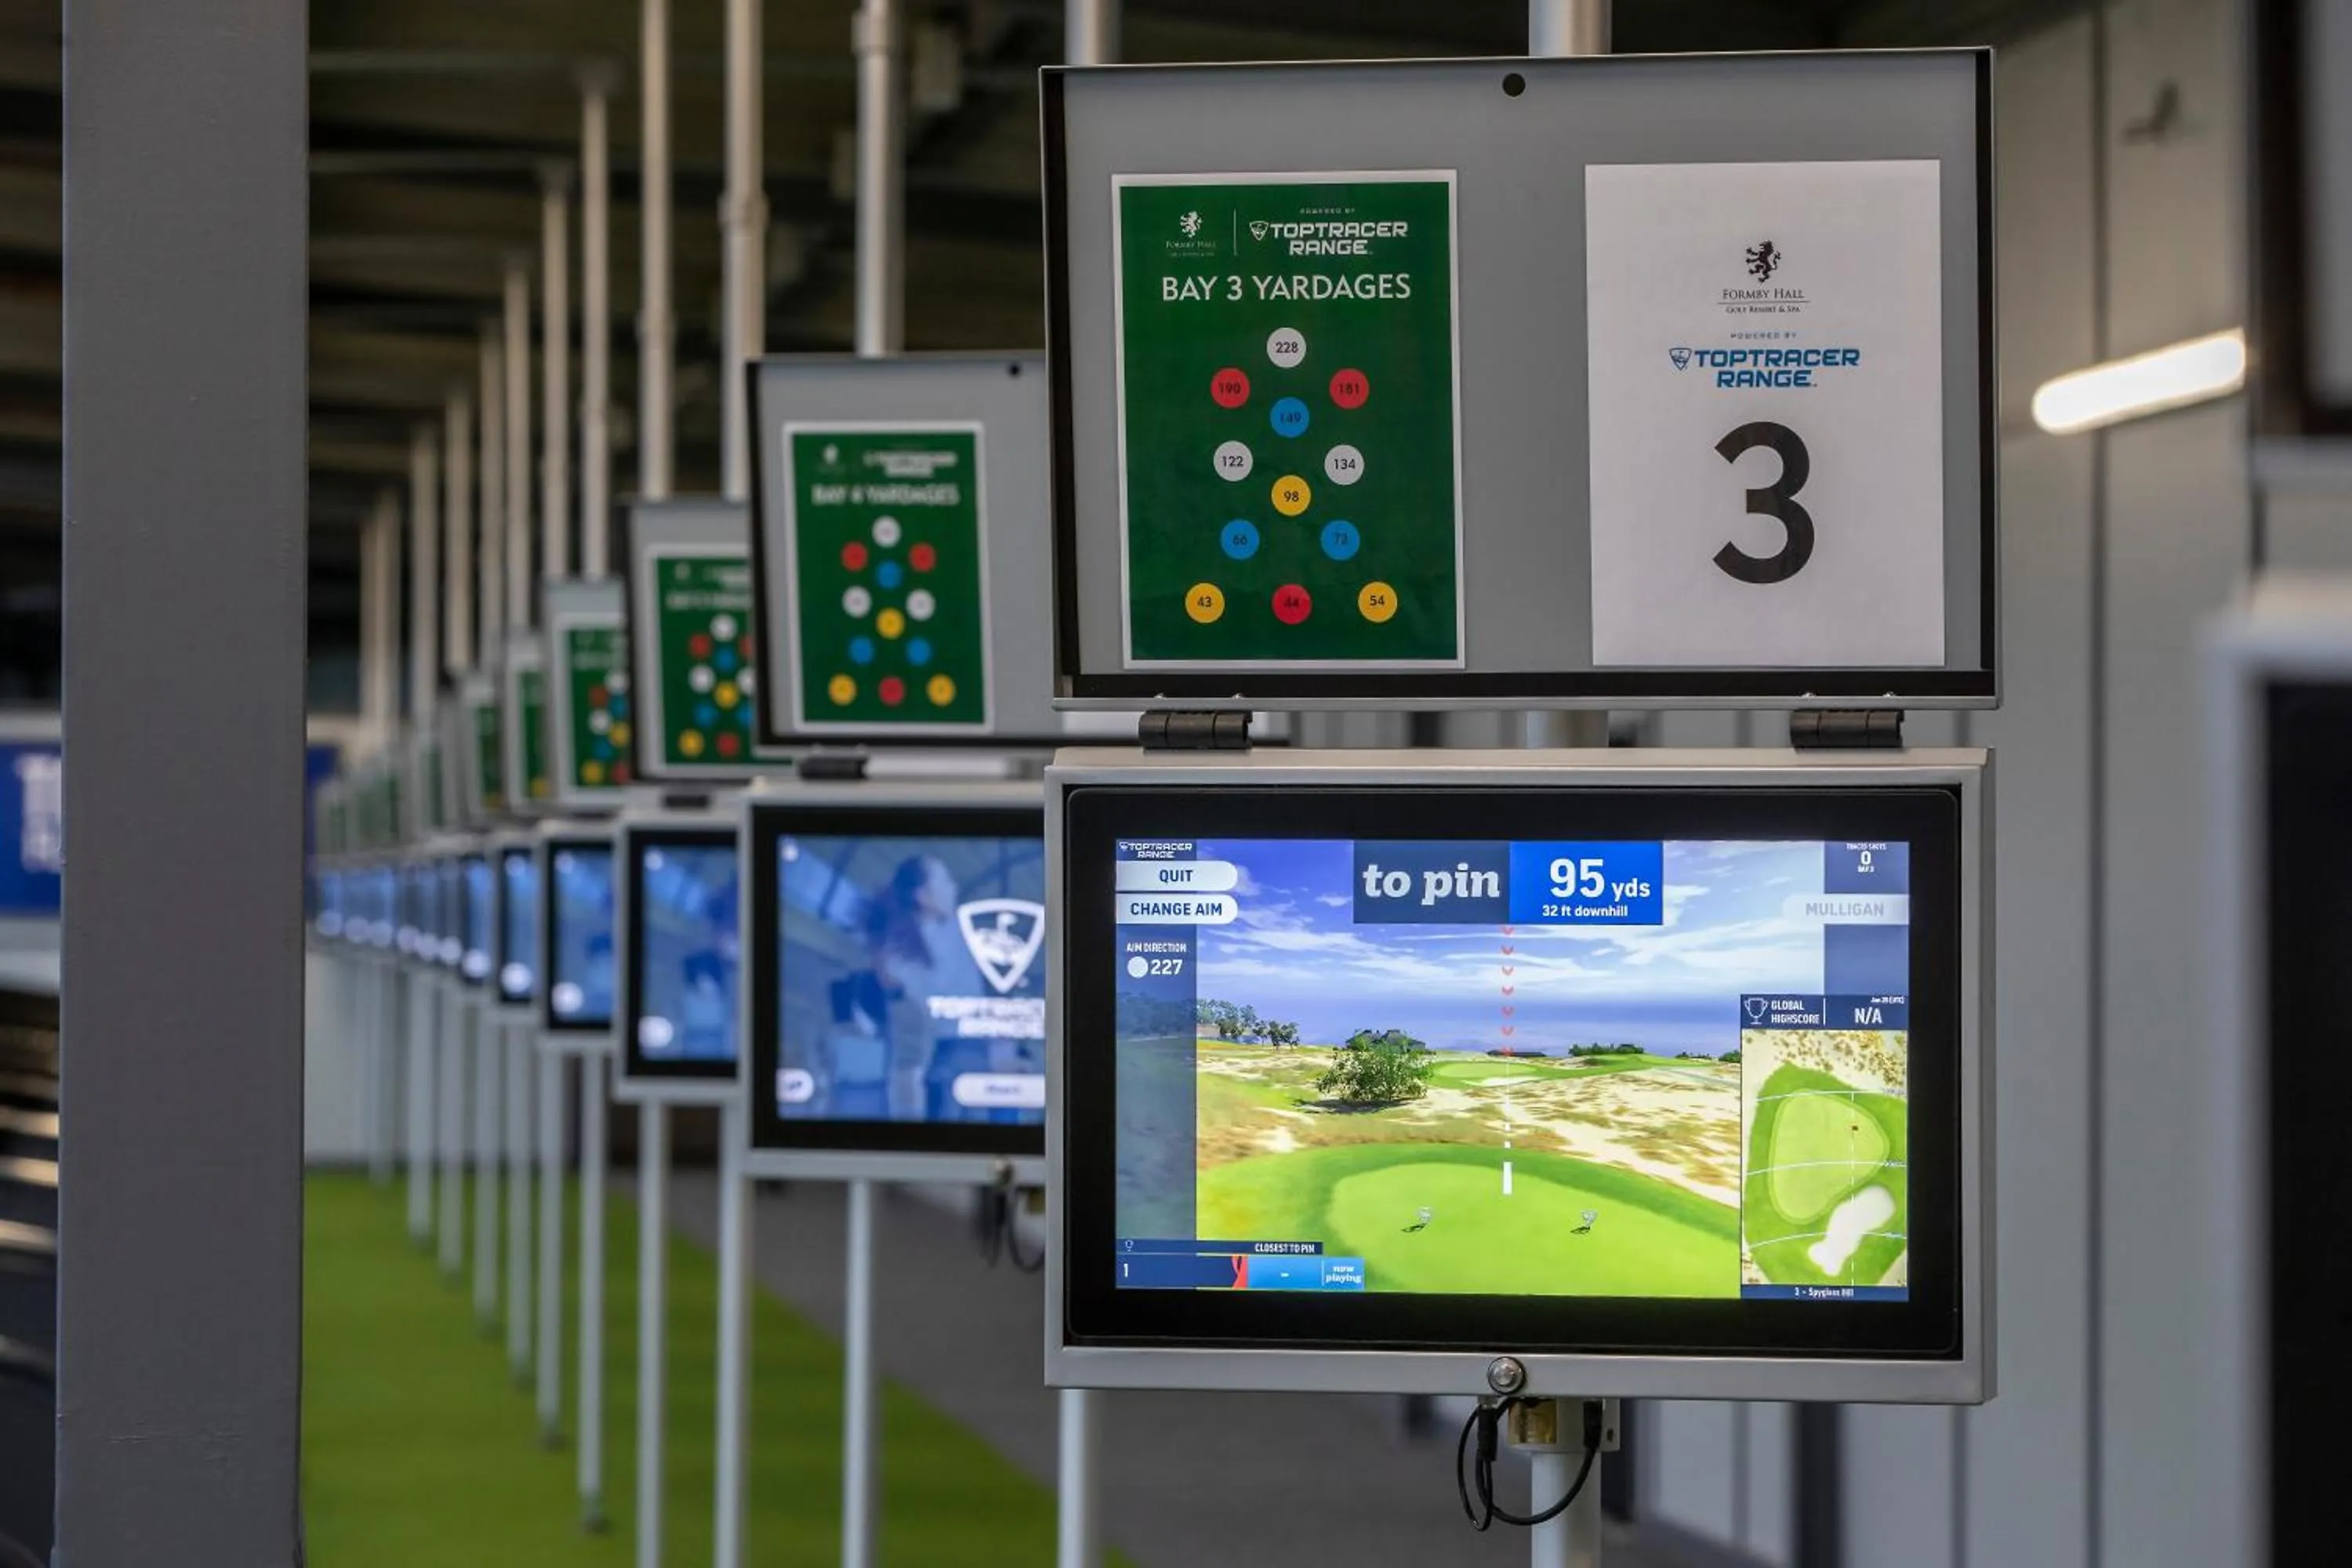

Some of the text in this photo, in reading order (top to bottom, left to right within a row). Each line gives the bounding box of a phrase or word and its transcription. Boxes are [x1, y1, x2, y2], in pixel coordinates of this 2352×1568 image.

[1270, 221, 1408, 238] TOPTRACER
[1289, 239, 1369, 256] RANGE
[1162, 274, 1410, 301] BAY 3 YARDAGES
[1722, 288, 1806, 299] FORMBY HALL
[1276, 341, 1299, 354] 228
[1693, 349, 1860, 368] TOPTRACER
[1716, 370, 1812, 388] RANGE
[1221, 456, 1244, 467] 122
[1334, 459, 1356, 470] 134
[1283, 490, 1299, 502] 98
[1713, 421, 1815, 584] 3
[1197, 596, 1212, 608] 43
[1370, 595, 1386, 607] 54
[1860, 851, 1871, 865] 0
[1159, 869, 1194, 883] QUIT
[1549, 858, 1651, 902] 95 yds
[1363, 863, 1501, 906] to pin
[1131, 902, 1223, 916] CHANGE AIM
[1542, 905, 1628, 916] 32 ft downhill
[1806, 902, 1884, 916] MULLIGAN
[1127, 943, 1186, 953] AIM DIRECTION
[1150, 959, 1183, 975] 227
[1771, 1000, 1805, 1011] GLOBAL
[1771, 1014, 1820, 1025] HIGHSCORE
[1854, 1007, 1882, 1025] N/A
[1254, 1243, 1315, 1254] CLOSEST TO PIN
[1123, 1263, 1129, 1277] 1
[1326, 1273, 1362, 1283] playing
